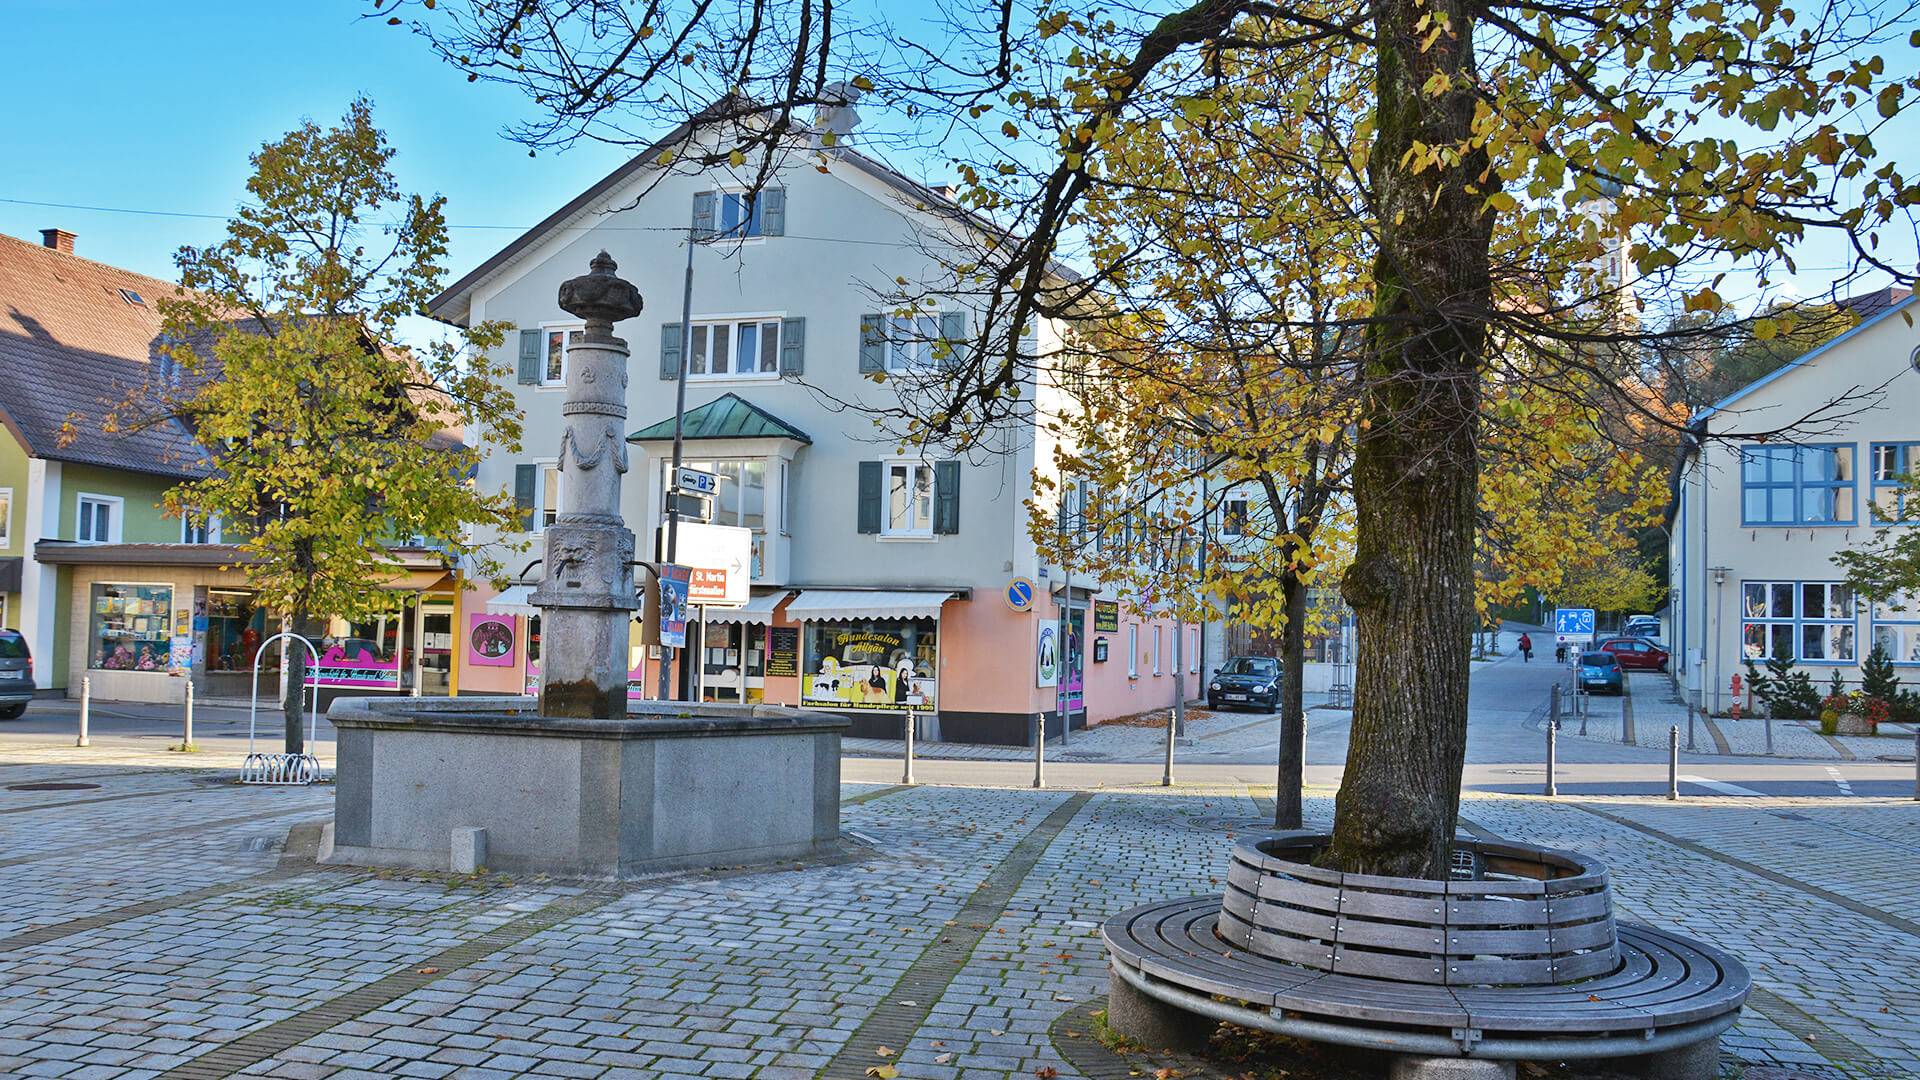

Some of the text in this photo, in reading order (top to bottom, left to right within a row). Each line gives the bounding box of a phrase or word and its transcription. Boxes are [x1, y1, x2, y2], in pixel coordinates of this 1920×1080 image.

[696, 571, 704, 582] St.
[706, 572, 725, 582] Martin
[836, 632, 900, 646] Hundesalon
[850, 641, 886, 654] Allgäu
